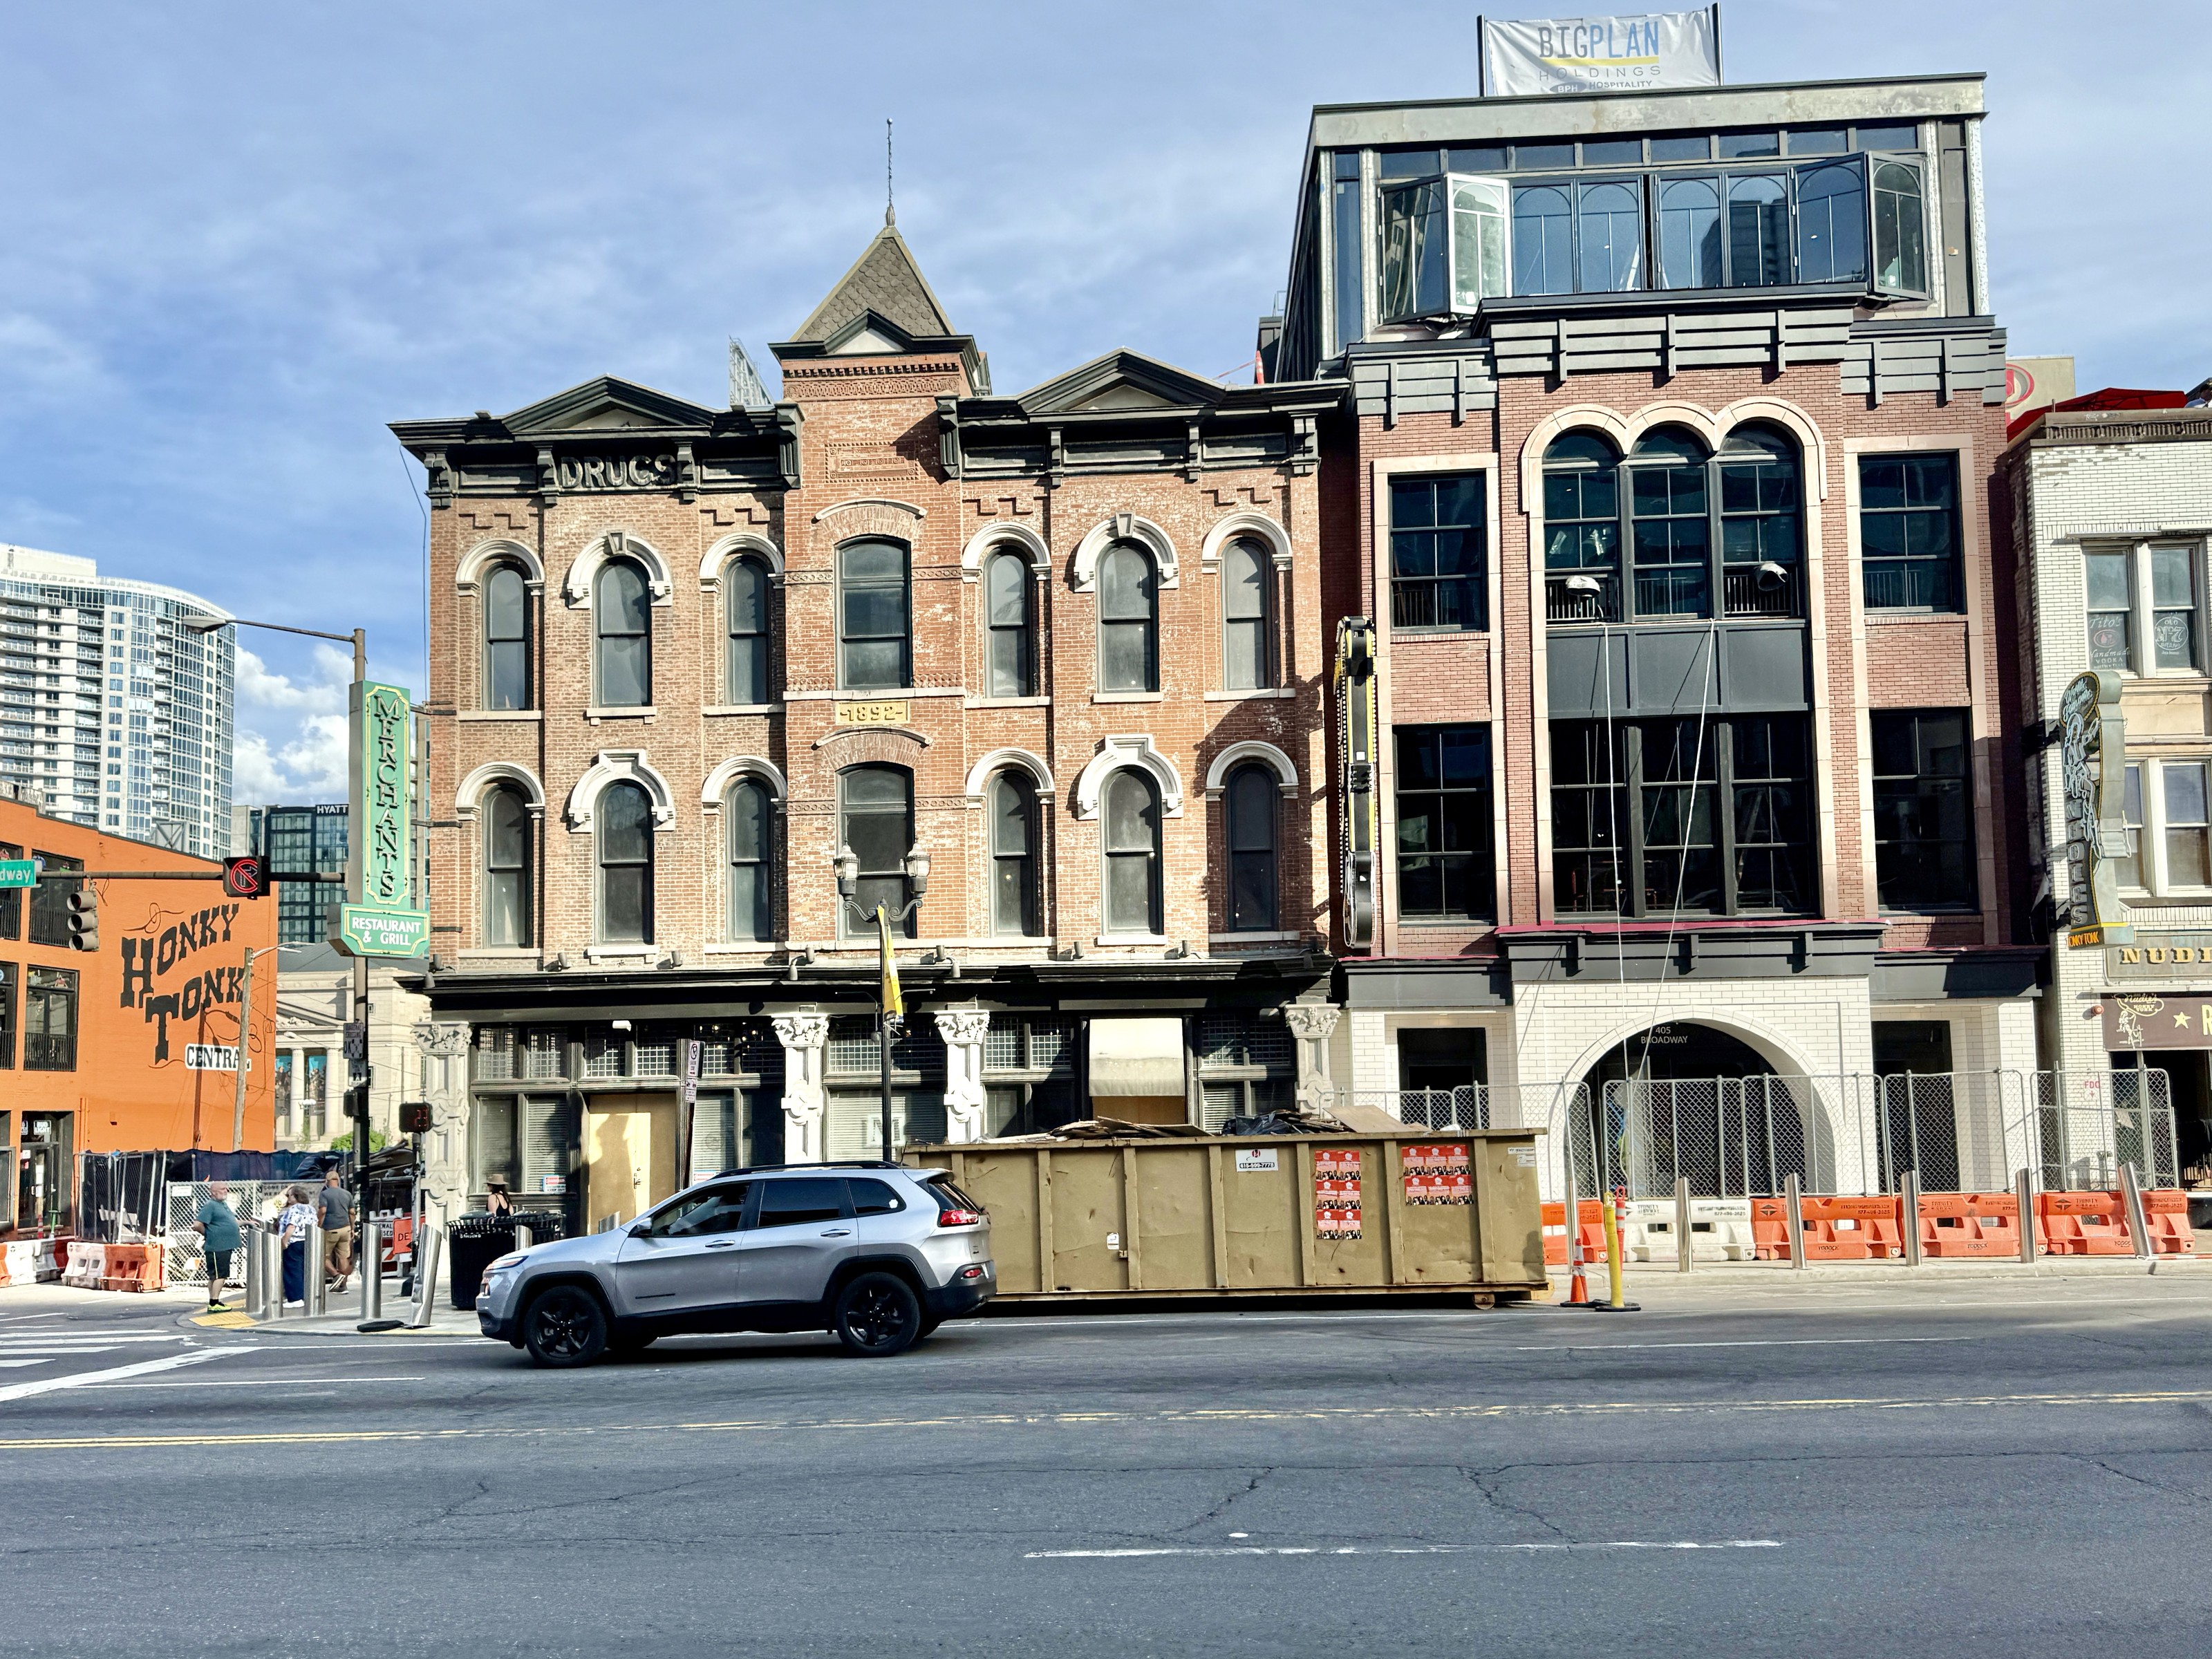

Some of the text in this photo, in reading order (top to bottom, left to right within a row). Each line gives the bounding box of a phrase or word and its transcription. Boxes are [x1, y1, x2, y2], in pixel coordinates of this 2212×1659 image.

[1539, 66, 1660, 81] HOLDINGS
[1557, 80, 1651, 93] BPH HOSPITALITY
[561, 455, 675, 487] DRUGS
[2089, 615, 2123, 629] Tito's
[374, 694, 400, 897] MERCHANTS
[317, 805, 348, 814] HYATT
[352, 917, 421, 934] RESTAURANT
[363, 930, 411, 946] & GRILL
[120, 903, 239, 1009] HONKY
[187, 1046, 250, 1069] CENTRA
[2084, 1080, 2101, 1089] FDC
